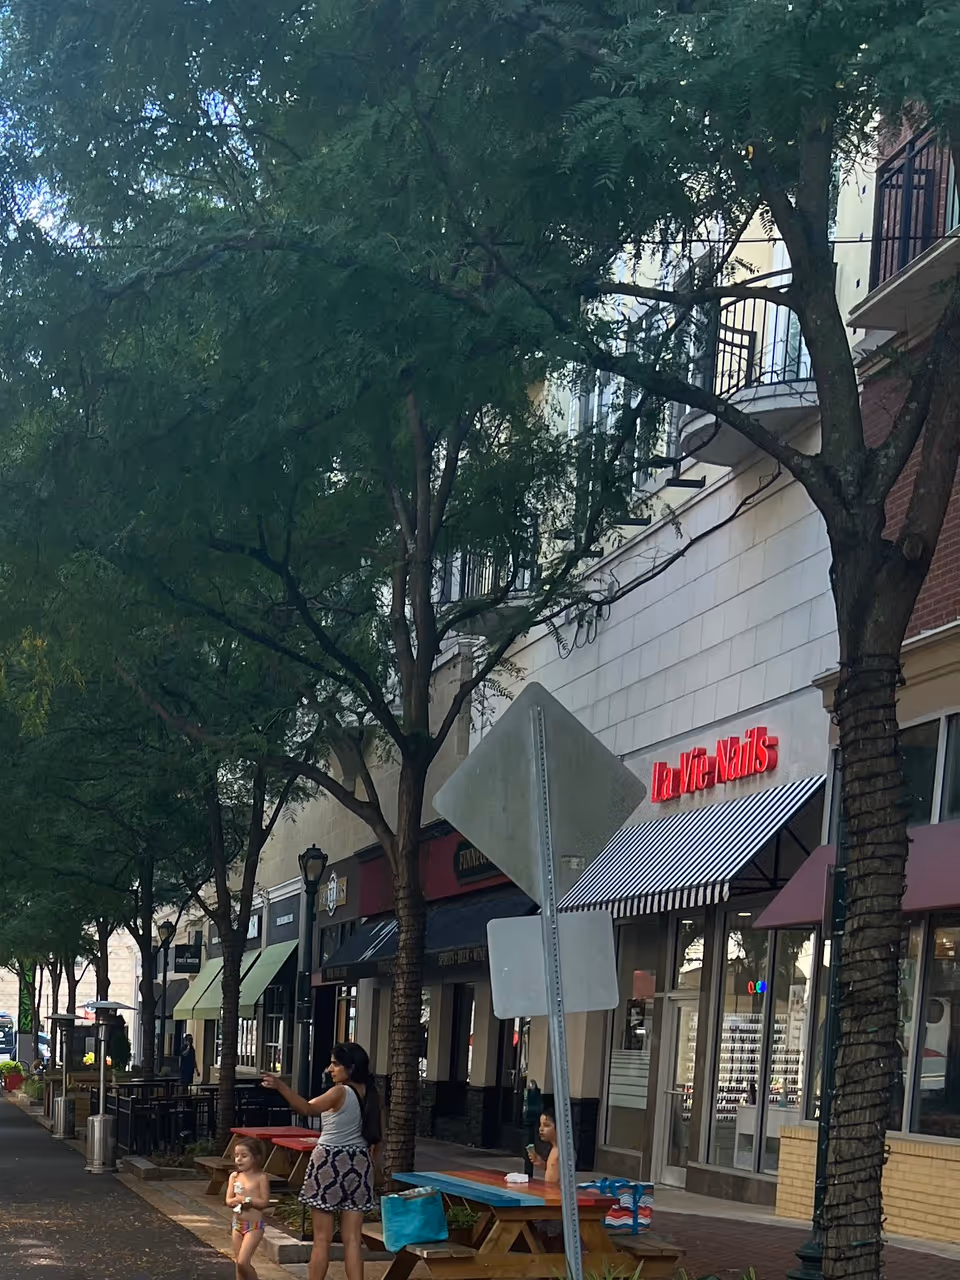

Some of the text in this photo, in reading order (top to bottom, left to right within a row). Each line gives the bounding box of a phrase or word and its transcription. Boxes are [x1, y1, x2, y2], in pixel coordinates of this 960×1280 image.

[651, 726, 778, 803] La Vie Nails
